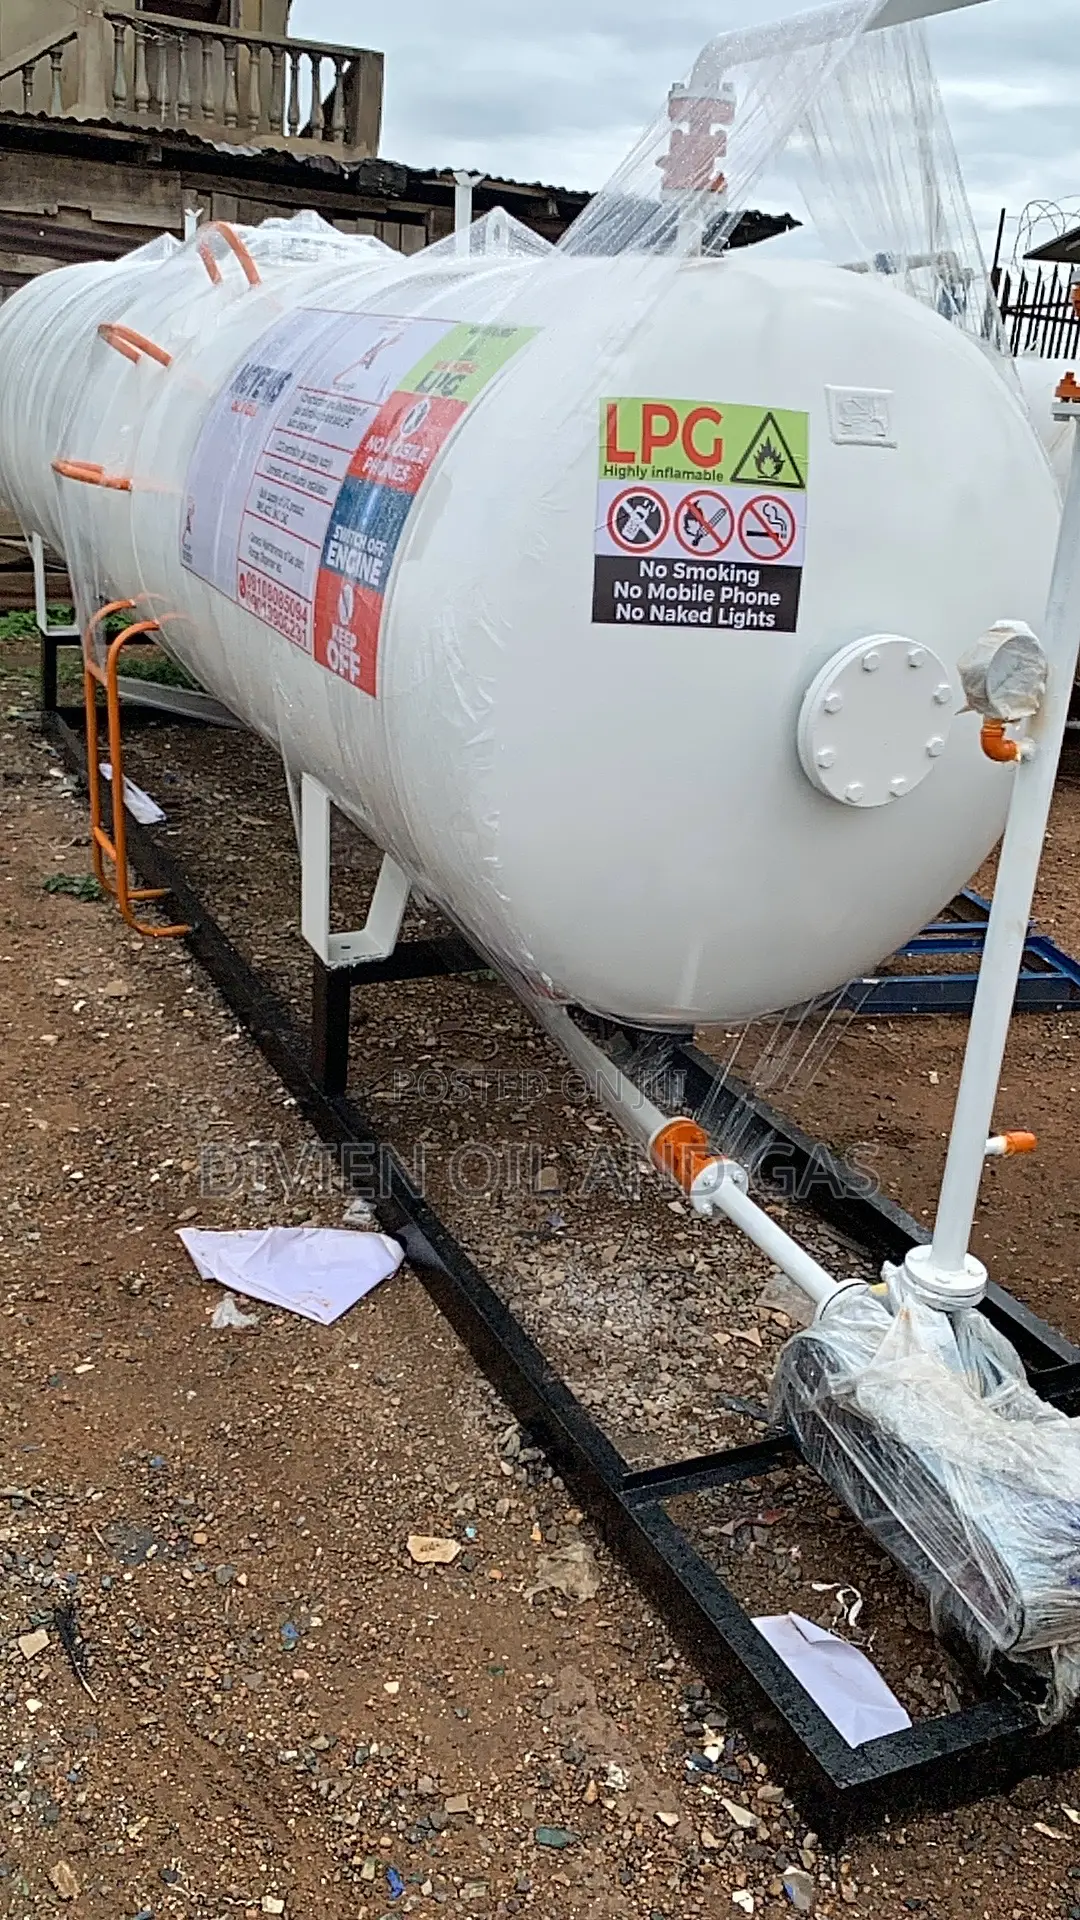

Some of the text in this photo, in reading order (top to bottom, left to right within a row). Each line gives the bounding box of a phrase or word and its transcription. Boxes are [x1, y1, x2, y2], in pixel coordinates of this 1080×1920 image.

[364, 434, 386, 455] NO
[606, 403, 724, 469] LPG
[603, 464, 724, 482] Highly inflamable
[333, 524, 368, 550] SWITCH
[326, 539, 383, 586] ENGINE
[639, 560, 760, 587] No Smoking
[613, 581, 781, 606] No Mobile Phone
[615, 603, 776, 629] No Naked Lights
[332, 623, 358, 650] KEEP
[327, 639, 361, 685] OFF
